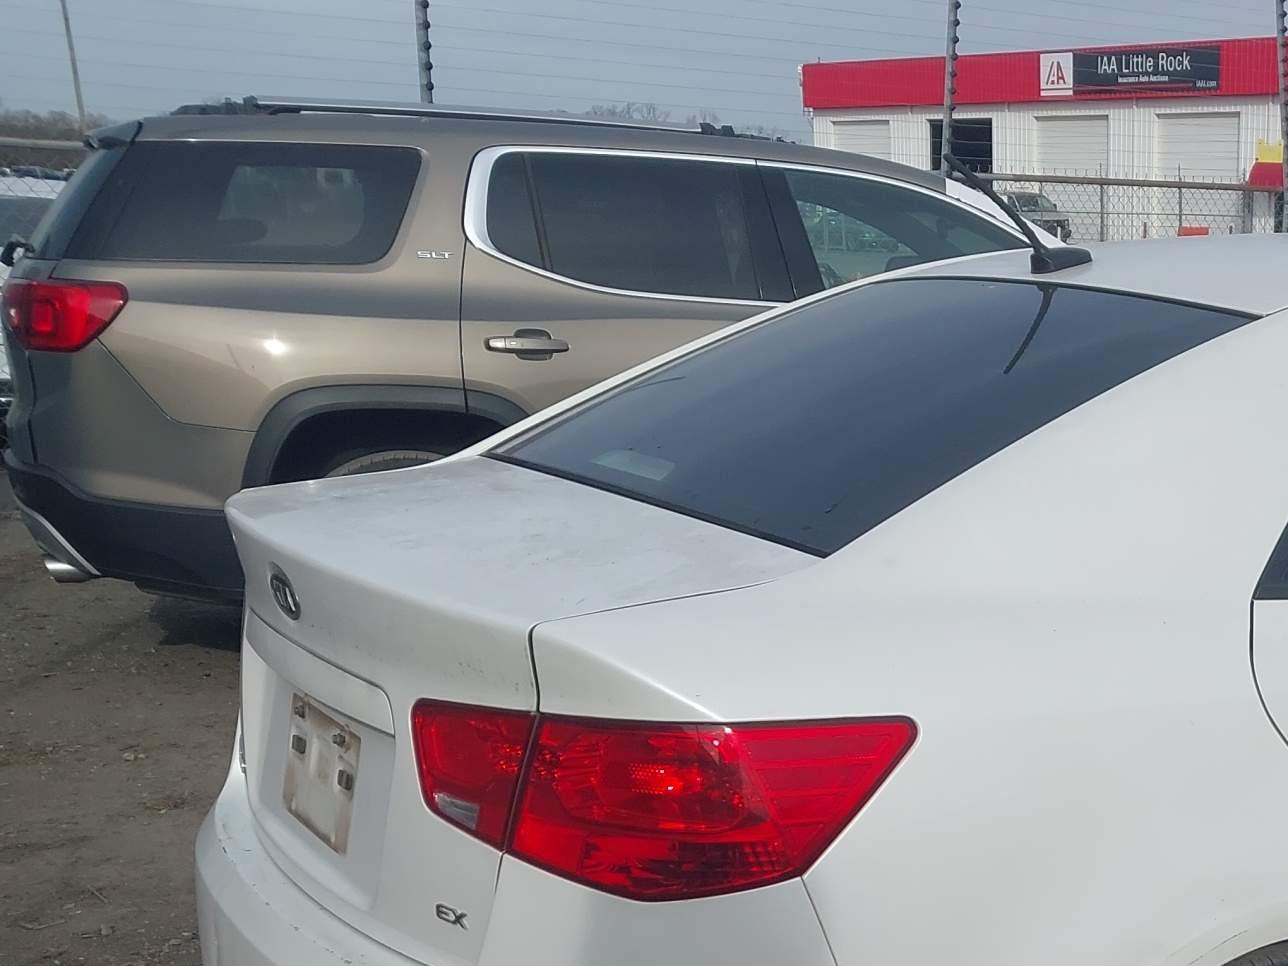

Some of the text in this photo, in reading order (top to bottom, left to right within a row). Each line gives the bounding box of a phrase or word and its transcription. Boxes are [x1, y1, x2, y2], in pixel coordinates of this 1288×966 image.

[1097, 51, 1191, 74] IAA Little Rock
[416, 250, 453, 259] SLT
[435, 903, 469, 930] EX
